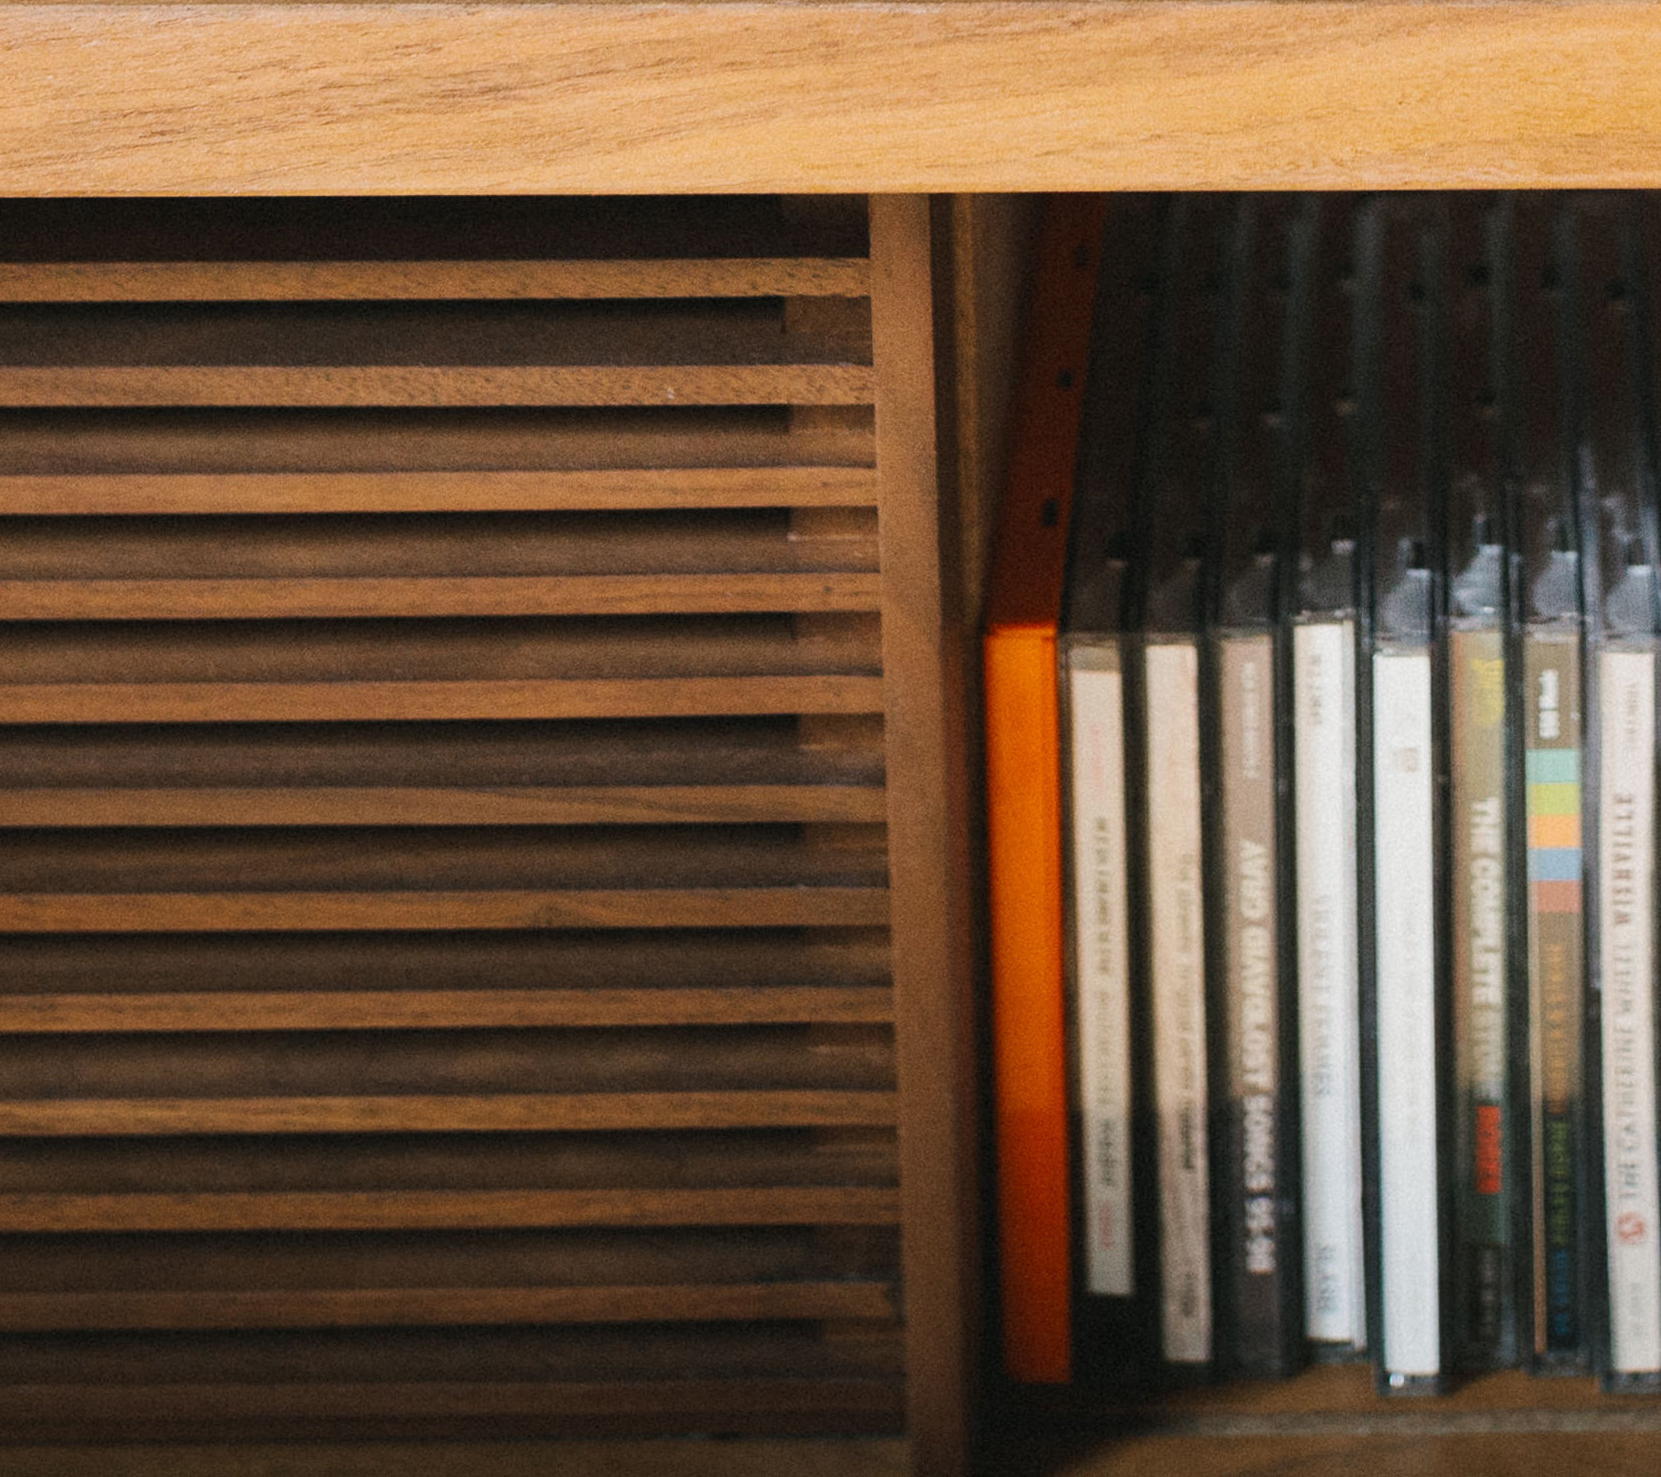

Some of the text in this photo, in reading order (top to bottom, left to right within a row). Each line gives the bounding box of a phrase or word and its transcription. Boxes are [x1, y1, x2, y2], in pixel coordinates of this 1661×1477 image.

[1470, 797, 1500, 854] THE
[1610, 792, 1636, 926] WISHVILLE
[1238, 840, 1271, 1021] DAVID GRAY
[1470, 858, 1502, 1005] COMPLETE
[1242, 1095, 1273, 1190] SONGS
[1614, 1025, 1639, 1153] CATHERINE
[1618, 1161, 1639, 1199] THE
